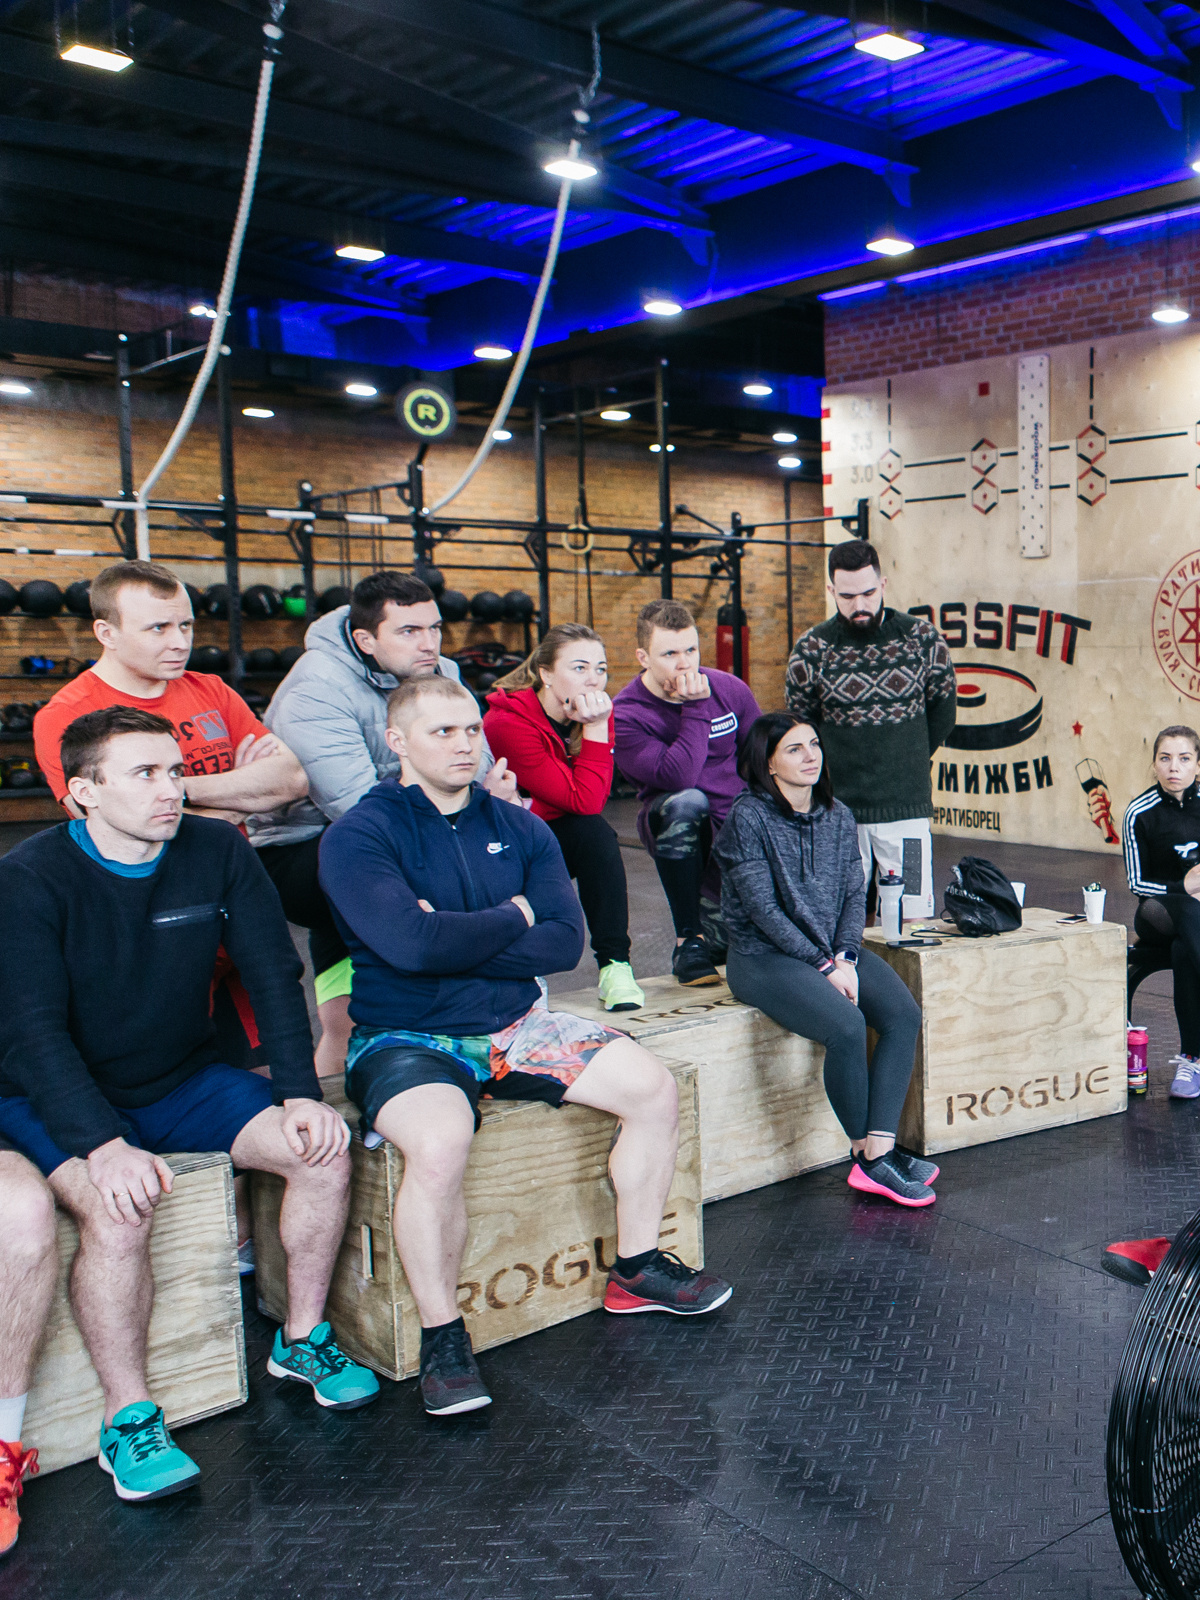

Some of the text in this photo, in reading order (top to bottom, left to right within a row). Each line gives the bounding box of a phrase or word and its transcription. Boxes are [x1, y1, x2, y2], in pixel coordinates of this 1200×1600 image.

[417, 403, 437, 421] R
[850, 465, 874, 484] 3.0
[936, 755, 1054, 795] МИЖБИ
[946, 1065, 1109, 1126] ROGUE
